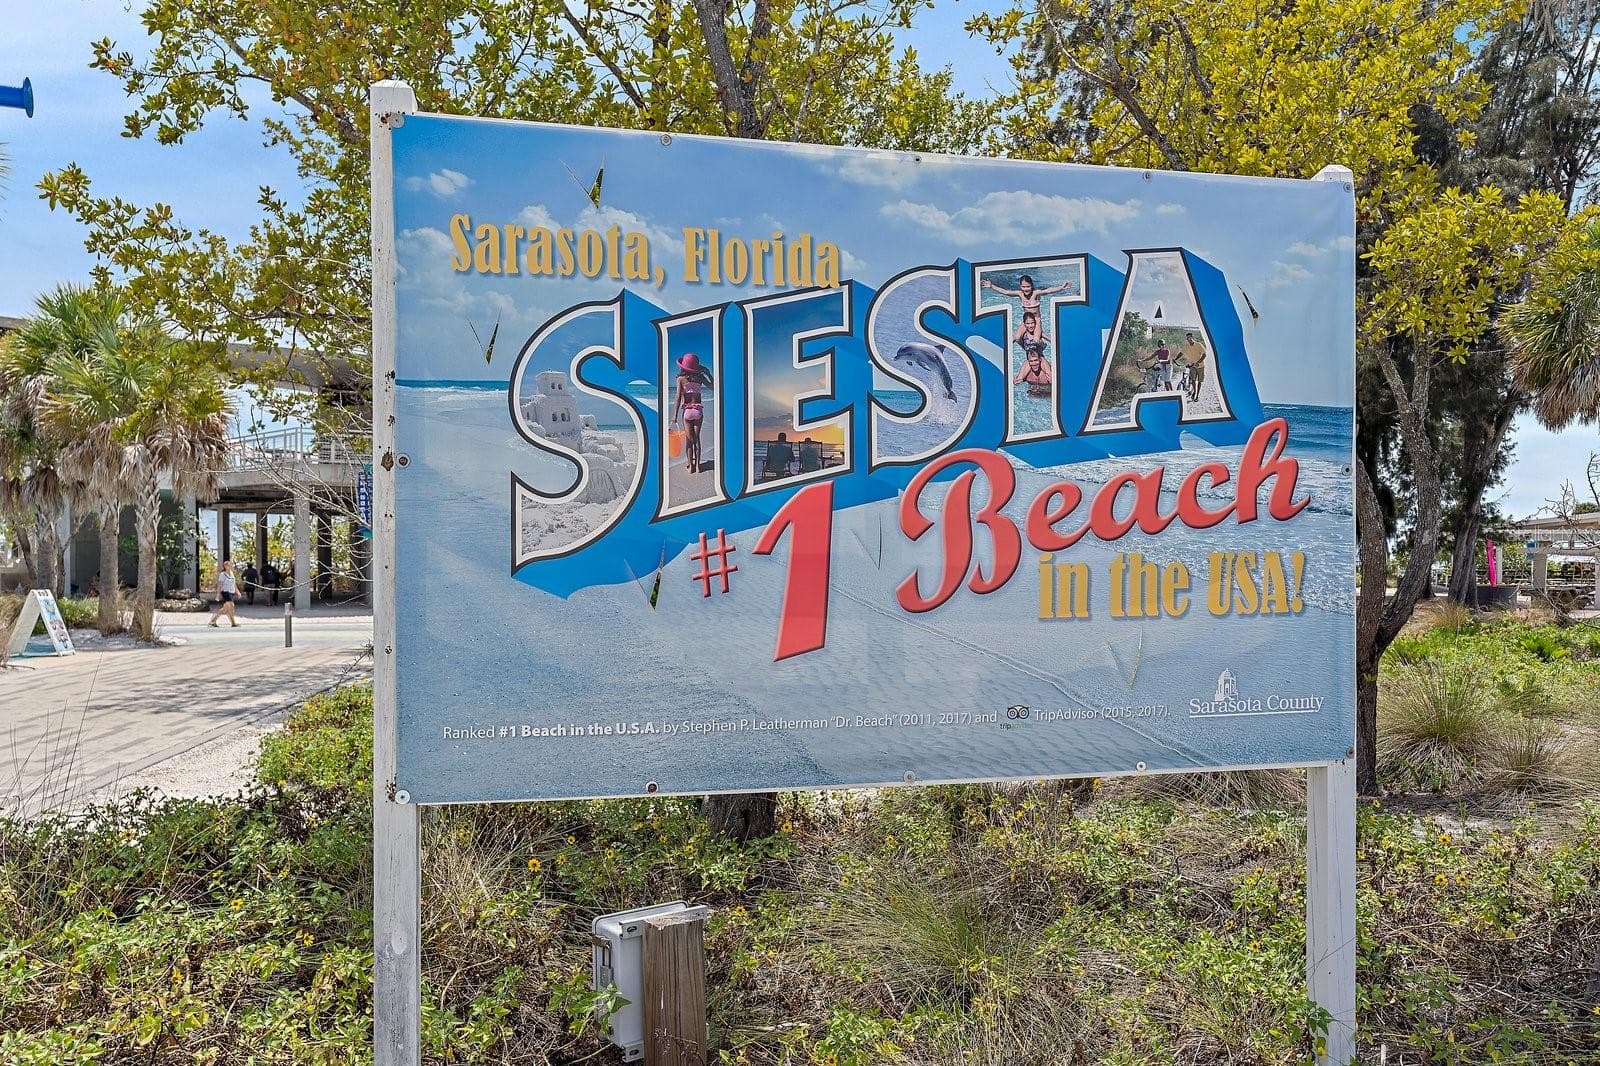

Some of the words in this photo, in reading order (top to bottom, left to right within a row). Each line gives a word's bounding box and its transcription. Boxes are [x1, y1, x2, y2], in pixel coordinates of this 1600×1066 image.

[449, 213, 665, 288] Sarasota,
[682, 227, 842, 288] Florida
[508, 247, 1240, 580] SIESTA
[690, 480, 835, 661] #1
[896, 417, 1312, 613] Beach
[1037, 552, 1089, 619] in
[1109, 554, 1191, 618] the
[1207, 550, 1307, 616] USA!
[443, 725, 495, 739] Ranked
[499, 725, 517, 738] #1
[521, 723, 567, 737] Beach
[570, 723, 585, 736] in
[588, 722, 613, 736] the
[616, 721, 660, 735] U.S.A.
[663, 720, 680, 736] by
[682, 719, 737, 735] Stephen
[740, 718, 751, 731] P.
[753, 716, 829, 731] Leatherman
[900, 713, 936, 727] (2011,
[939, 711, 973, 726] 2017)
[975, 710, 998, 724] and
[1034, 708, 1099, 722] TripAdvisor
[1101, 706, 1135, 720] (2015,
[1138, 704, 1171, 719] 2017).
[1189, 697, 1263, 714] Sarasota
[1266, 693, 1324, 713] County
